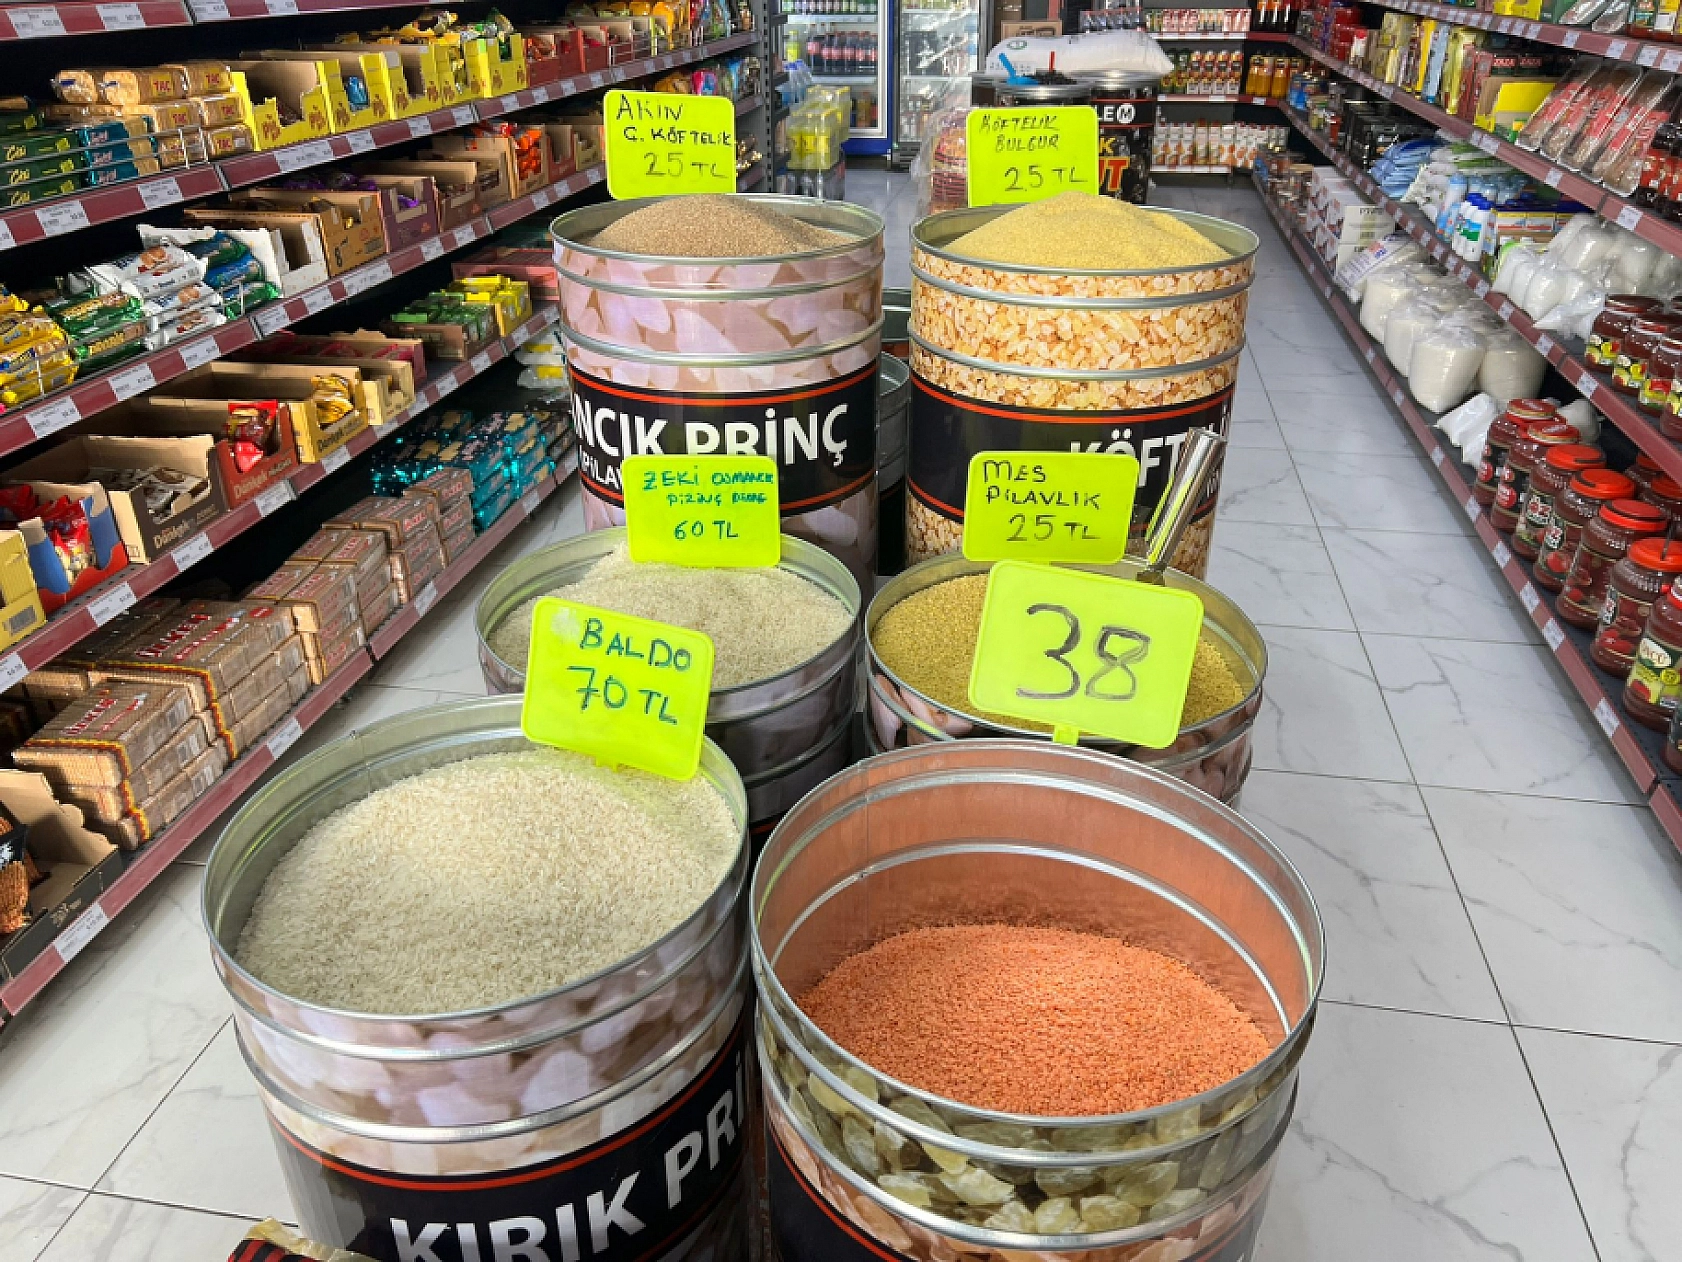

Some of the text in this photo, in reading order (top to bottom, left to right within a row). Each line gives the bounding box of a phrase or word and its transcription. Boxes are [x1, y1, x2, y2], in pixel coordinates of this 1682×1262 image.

[643, 152, 684, 177] 25
[1051, 166, 1089, 184] TL
[982, 460, 1048, 483] MES
[673, 520, 739, 541] 60 TL
[1006, 514, 1101, 542] 25 TL
[579, 617, 692, 672] BALDO
[1015, 603, 1151, 700] 38
[566, 665, 678, 726] 70 TL
[389, 1170, 648, 1262] KIRIK
